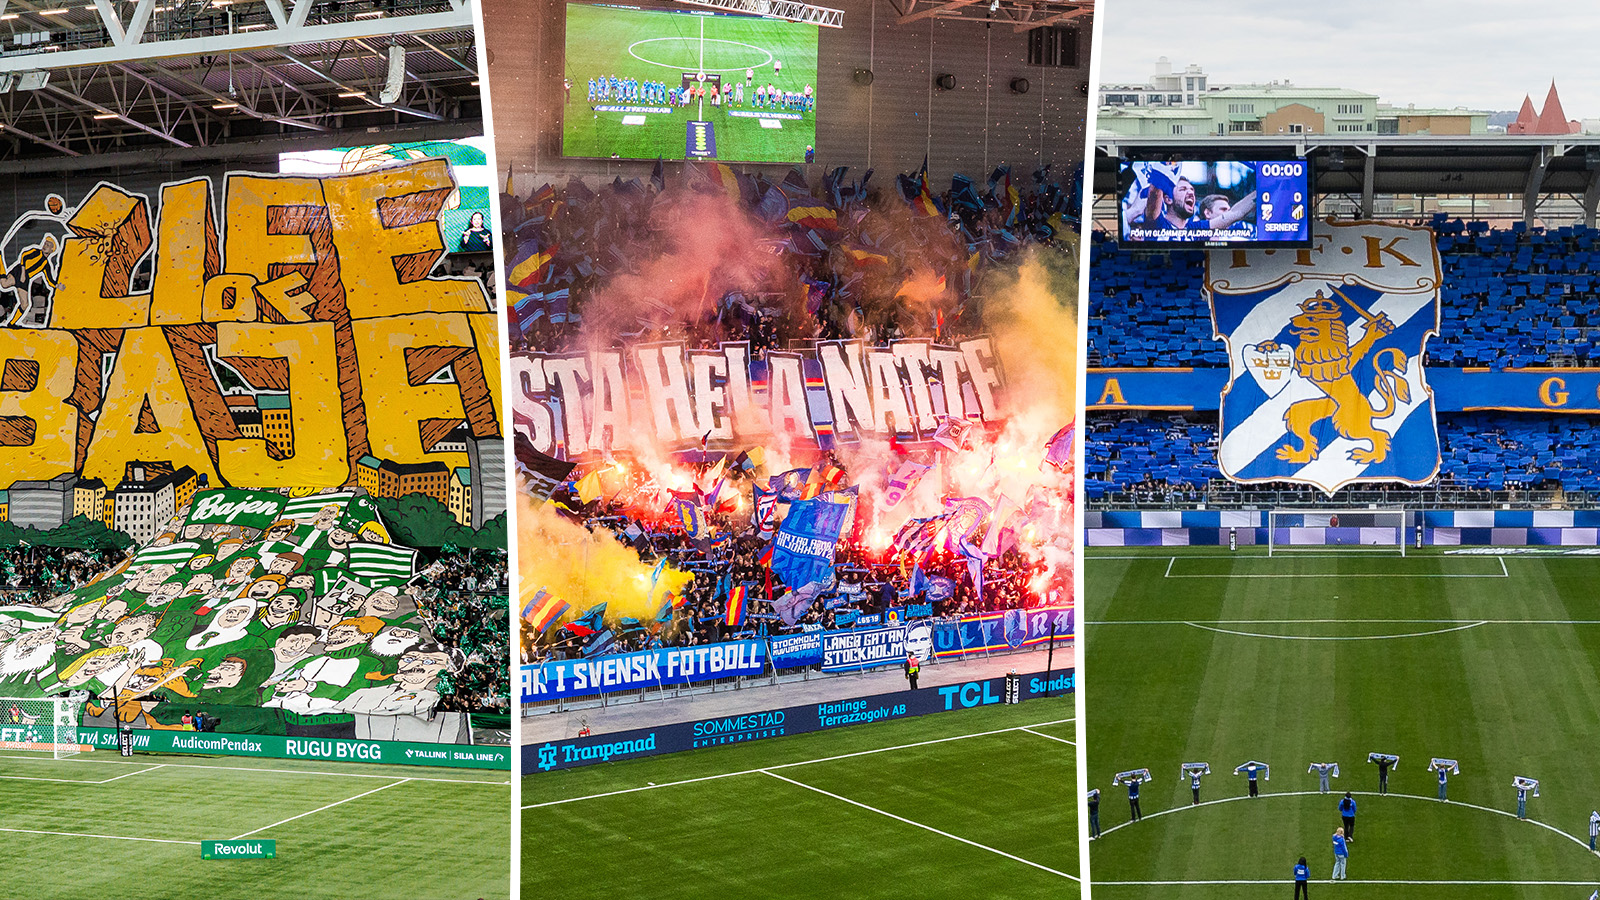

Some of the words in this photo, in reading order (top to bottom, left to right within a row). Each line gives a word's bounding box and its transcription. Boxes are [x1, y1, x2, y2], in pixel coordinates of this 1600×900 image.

[1262, 164, 1302, 177] 00:00
[1262, 192, 1270, 202] 0
[1294, 192, 1302, 202] 0
[1130, 229, 1144, 237] FÖR
[1145, 229, 1152, 237] VI
[1153, 228, 1187, 237] GLÖMMER
[1188, 229, 1212, 237] ALDRIG
[1214, 228, 1251, 237] ÄNGLARNA
[1264, 223, 1299, 232] SERNEKE
[48, 160, 490, 328] LIFE
[202, 271, 317, 322] OF
[0, 312, 503, 488] BAJE
[638, 345, 814, 439] HELA
[1096, 378, 1128, 404] A
[1539, 376, 1570, 407] G
[191, 492, 278, 522] Bajen
[322, 570, 390, 594] HF
[772, 634, 820, 650] STOCKHOLM
[864, 628, 905, 645] GATAN
[824, 642, 903, 665] STOCKHOLM
[556, 665, 566, 692] I
[574, 653, 661, 690] SVENSK
[667, 643, 761, 678] FOTBOLL
[1030, 673, 1075, 694] Sundst
[938, 680, 1000, 710] TCL
[818, 700, 866, 716] Haninge
[819, 708, 889, 727] Terrazzogolv
[892, 704, 906, 715] AB
[694, 711, 785, 736] SOMMESTAD
[80, 731, 98, 744] TVÅ
[133, 735, 150, 747] VIN
[172, 736, 262, 751] AudicomPendax
[562, 734, 656, 762] Tranpenad
[694, 728, 785, 748] ENTERPRISES
[286, 740, 331, 756] RUGU
[336, 742, 381, 759] BYGG
[415, 750, 447, 758] TALLINK
[215, 843, 262, 854] Revolut
